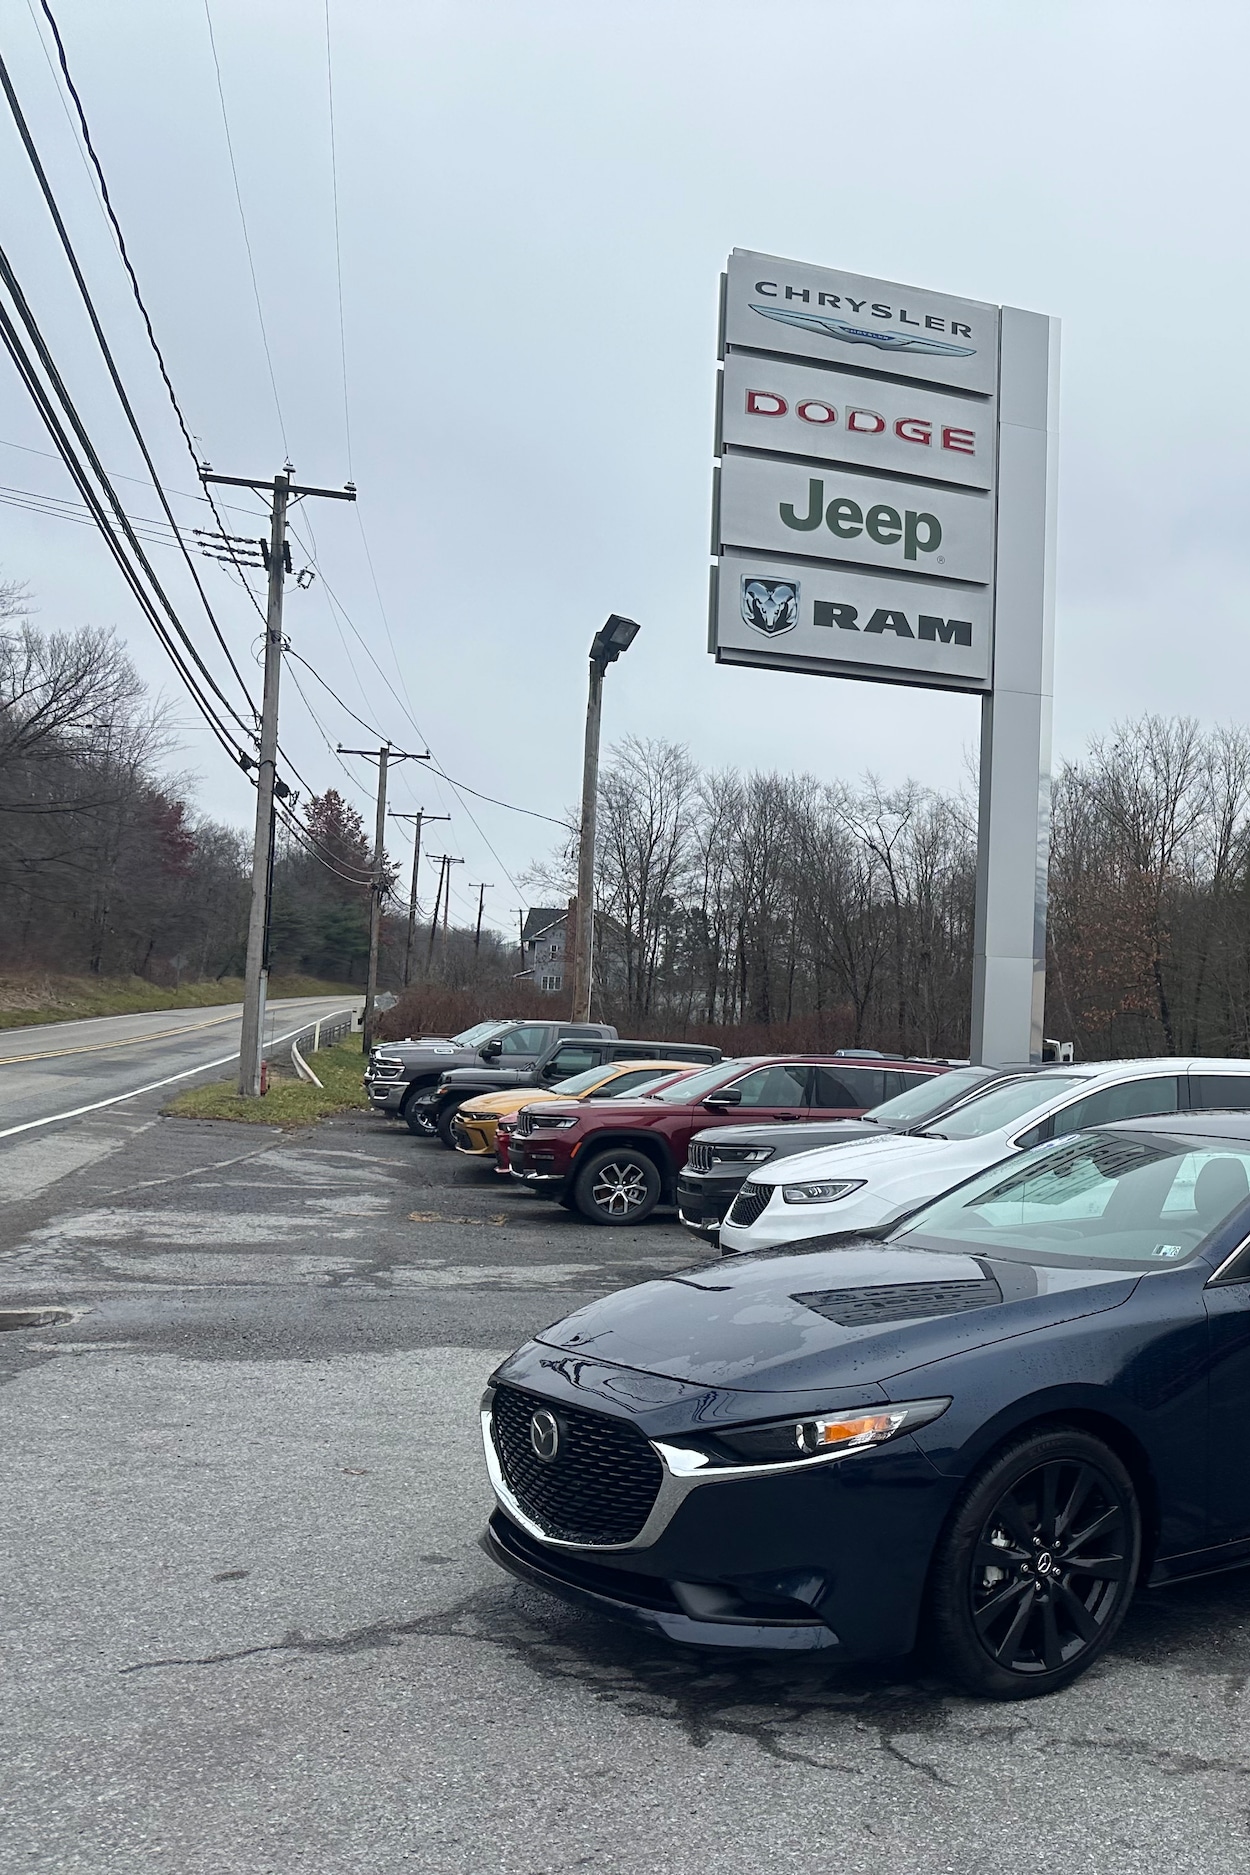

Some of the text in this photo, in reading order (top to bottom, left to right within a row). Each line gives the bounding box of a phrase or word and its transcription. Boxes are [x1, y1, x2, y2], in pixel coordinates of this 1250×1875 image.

[754, 281, 972, 339] CHRYSLER
[745, 388, 976, 456] DODGE
[779, 478, 942, 561] Jeep
[813, 600, 972, 647] RAM
